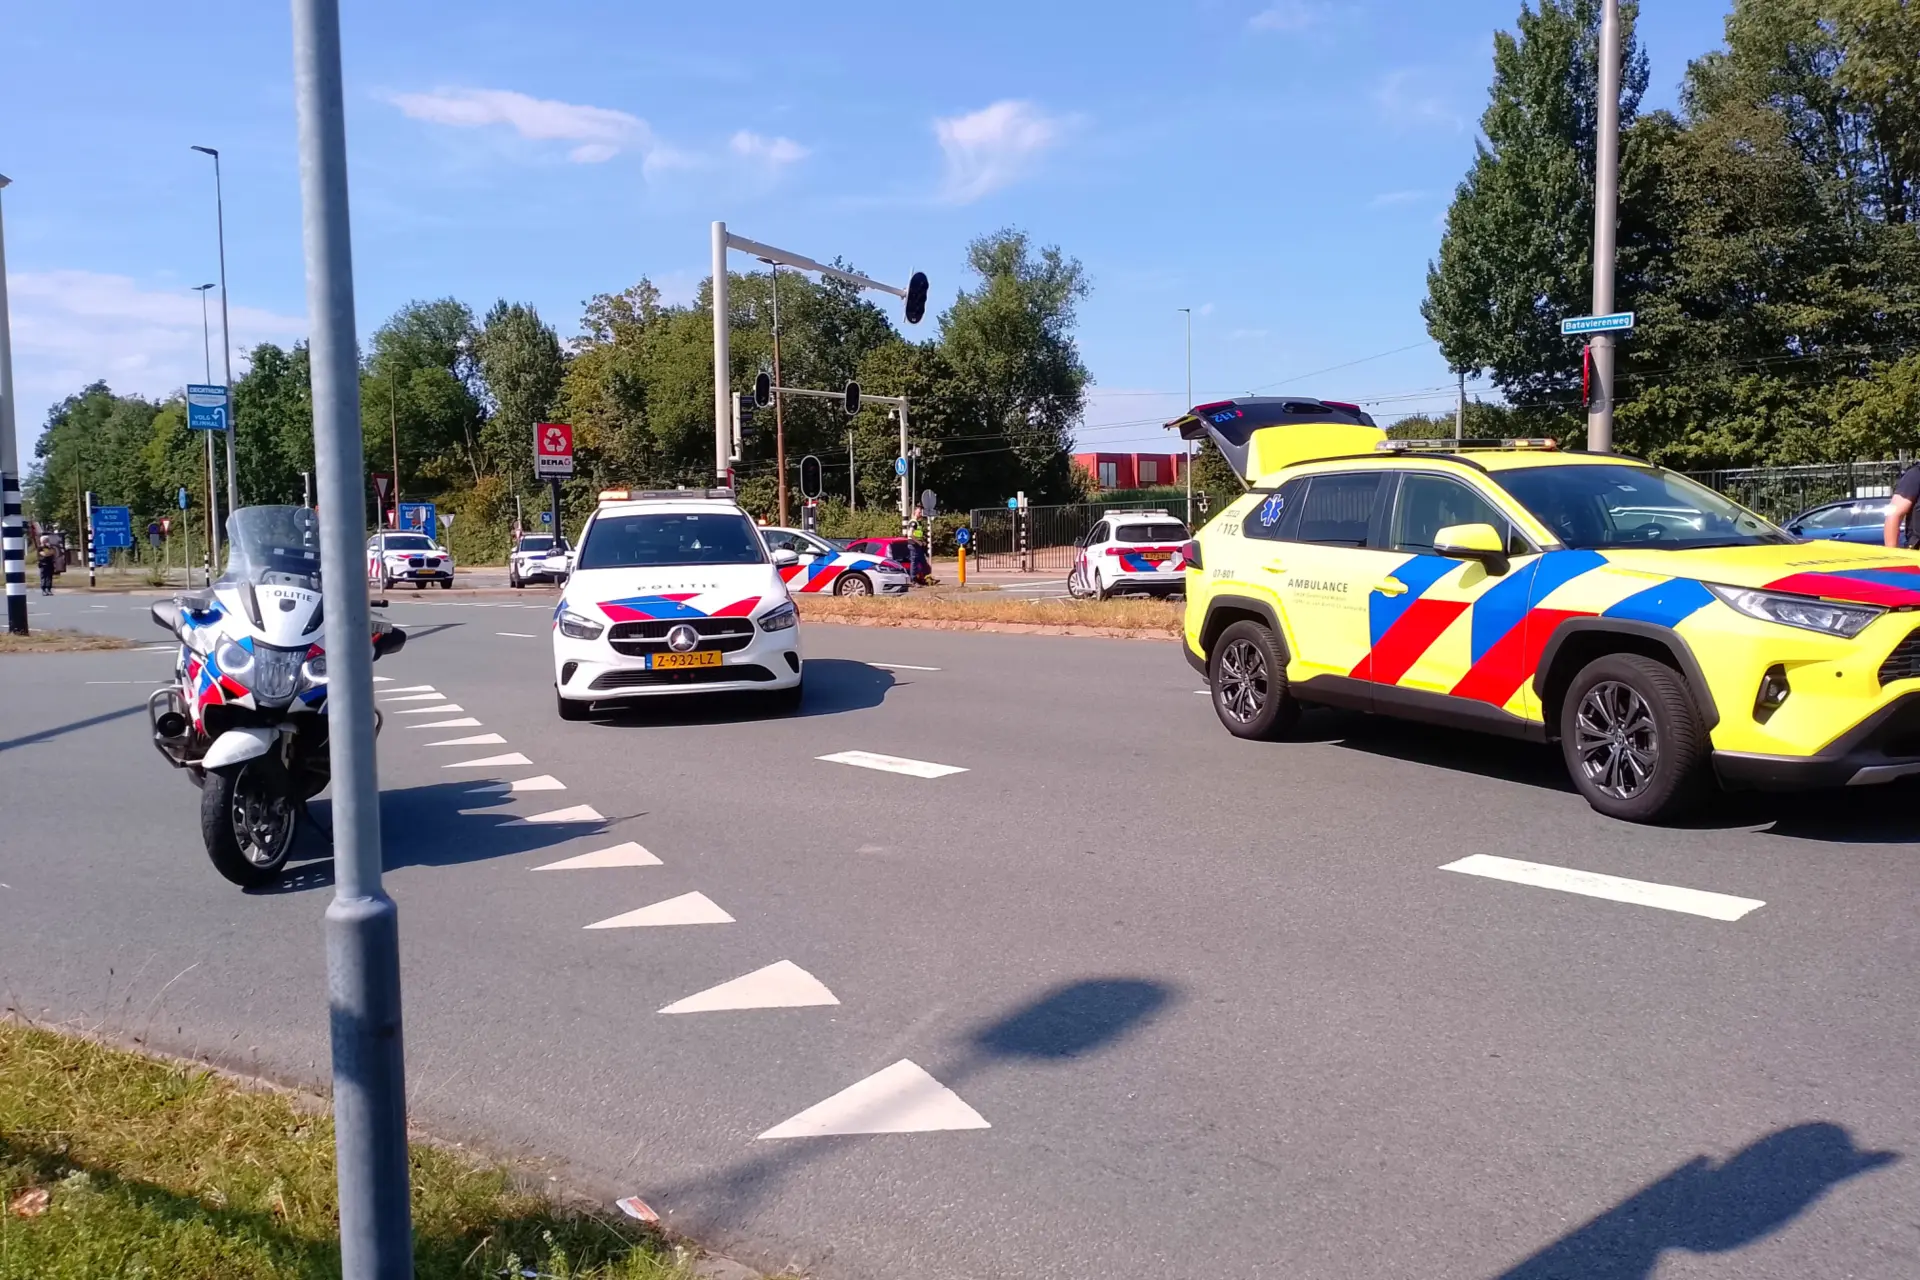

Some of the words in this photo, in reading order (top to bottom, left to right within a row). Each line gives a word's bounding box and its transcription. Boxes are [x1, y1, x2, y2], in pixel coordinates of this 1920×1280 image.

[1565, 317, 1629, 330] Batavierenweg
[1215, 411, 1235, 422] 112
[1223, 523, 1239, 536] 112
[1785, 556, 1912, 566] AMBULANCE
[637, 583, 719, 591] POLITIE
[1288, 578, 1348, 593] AMBULANCE
[266, 590, 313, 602] OLITIE
[657, 653, 715, 667] Z-932-LZ
